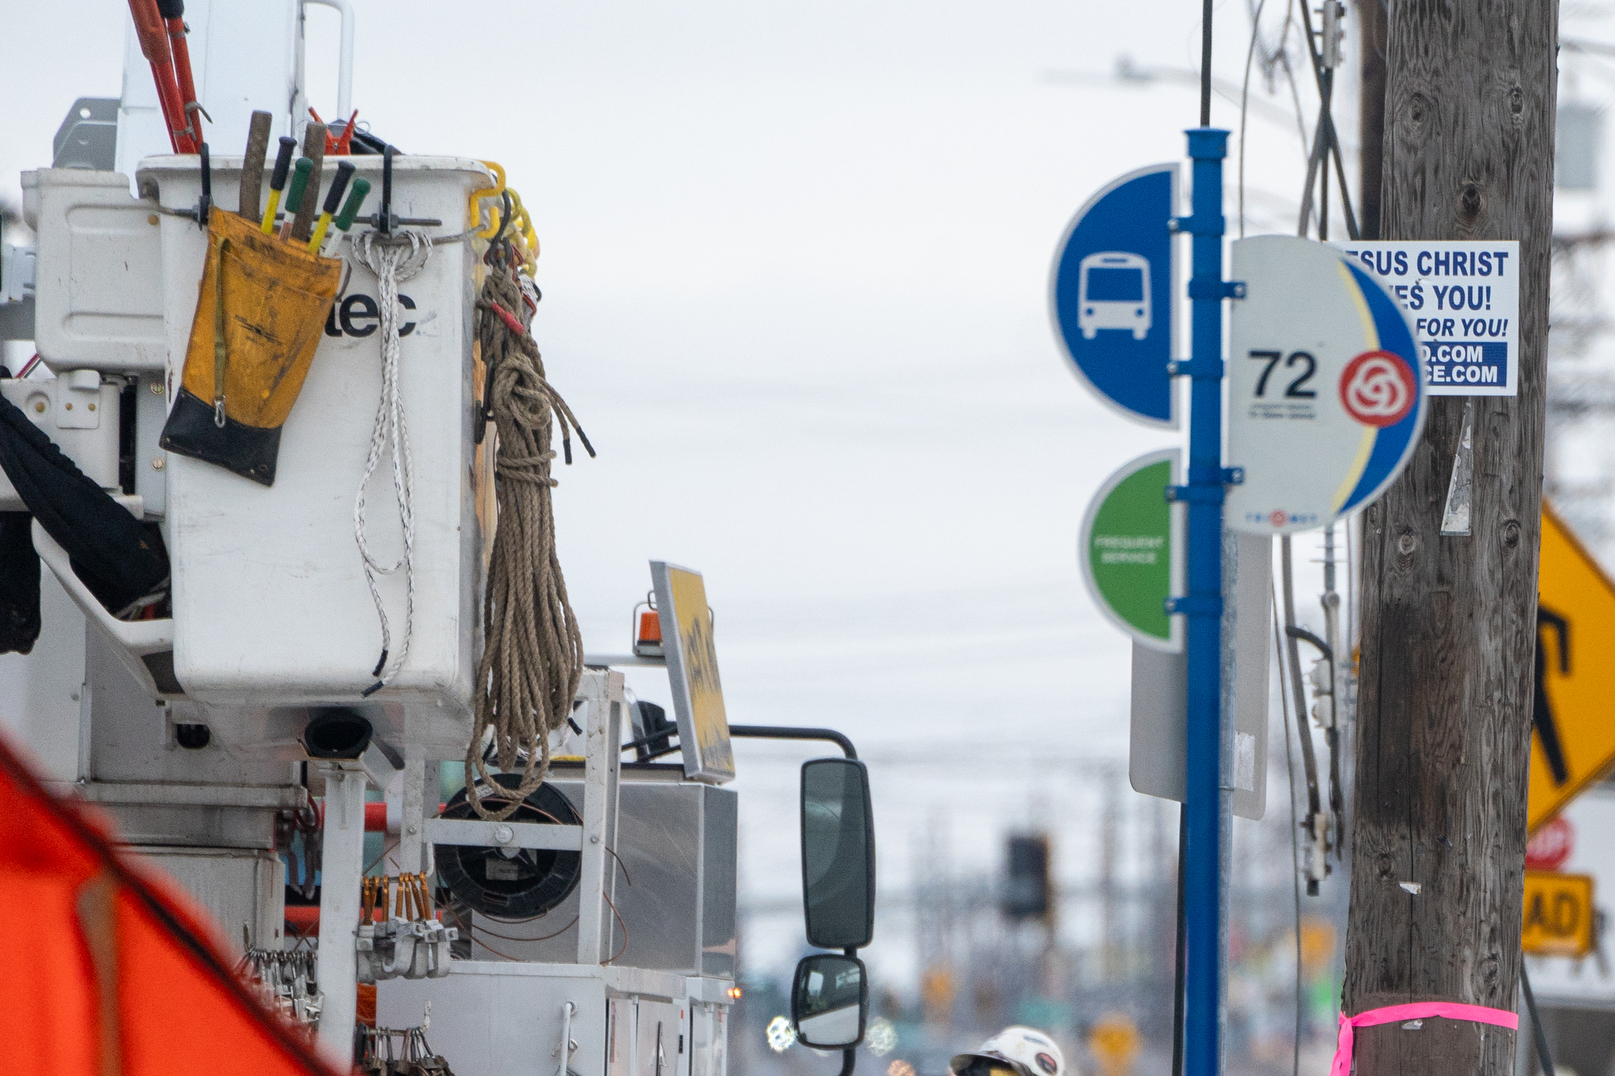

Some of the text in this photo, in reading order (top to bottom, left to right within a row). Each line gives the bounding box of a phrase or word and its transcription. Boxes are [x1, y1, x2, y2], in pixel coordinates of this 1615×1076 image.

[1345, 250, 1509, 276] SUS CHRIST
[1432, 285, 1491, 311] YOU!
[1416, 318, 1509, 337] FOR YOU!
[1248, 350, 1317, 398] 72
